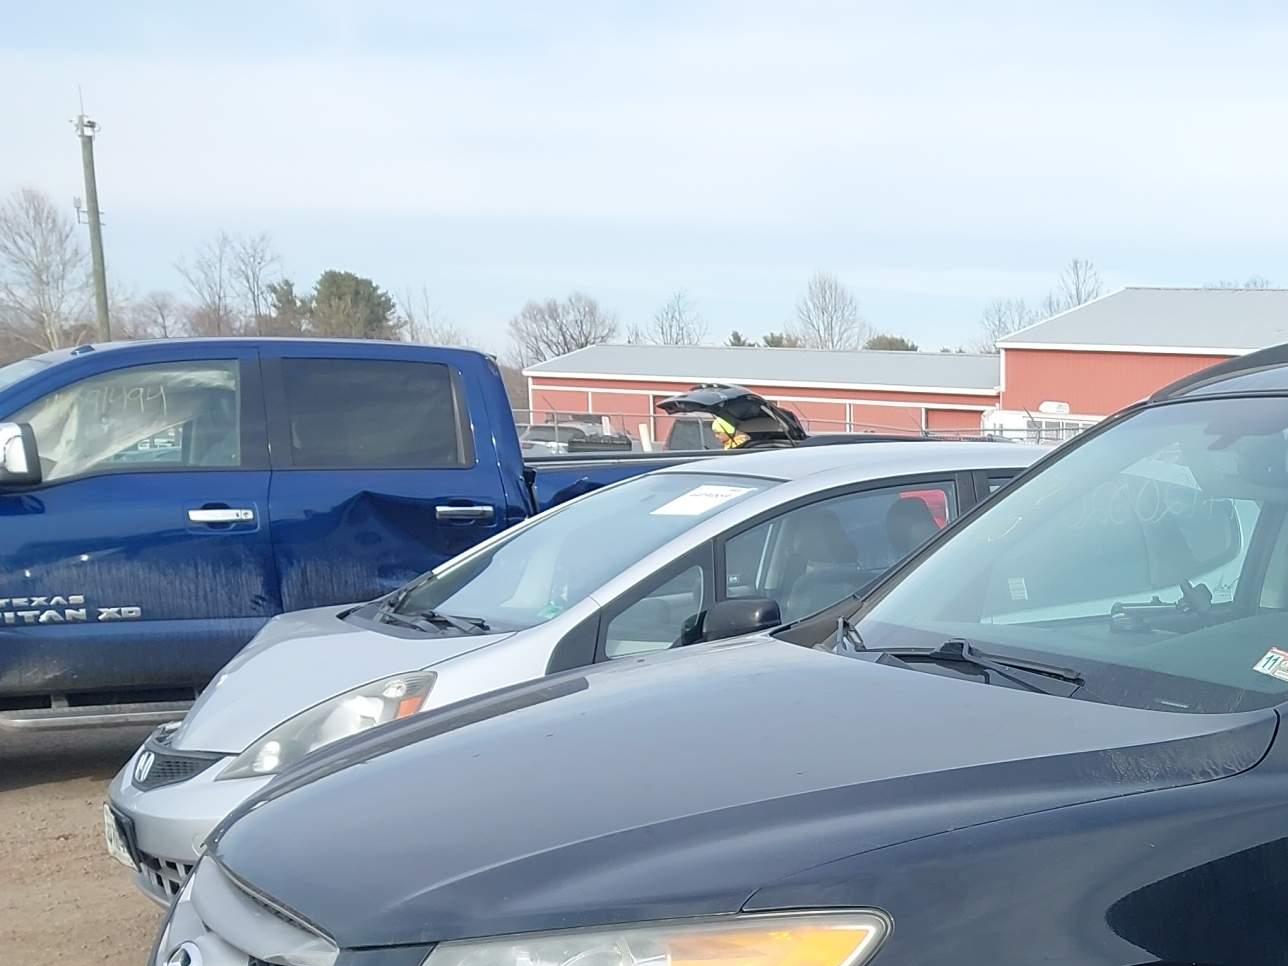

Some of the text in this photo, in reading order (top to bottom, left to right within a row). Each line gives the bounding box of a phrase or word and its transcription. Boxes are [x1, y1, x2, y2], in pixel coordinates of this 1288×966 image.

[0, 606, 142, 623] ITAN XD
[1262, 655, 1281, 670] 11
